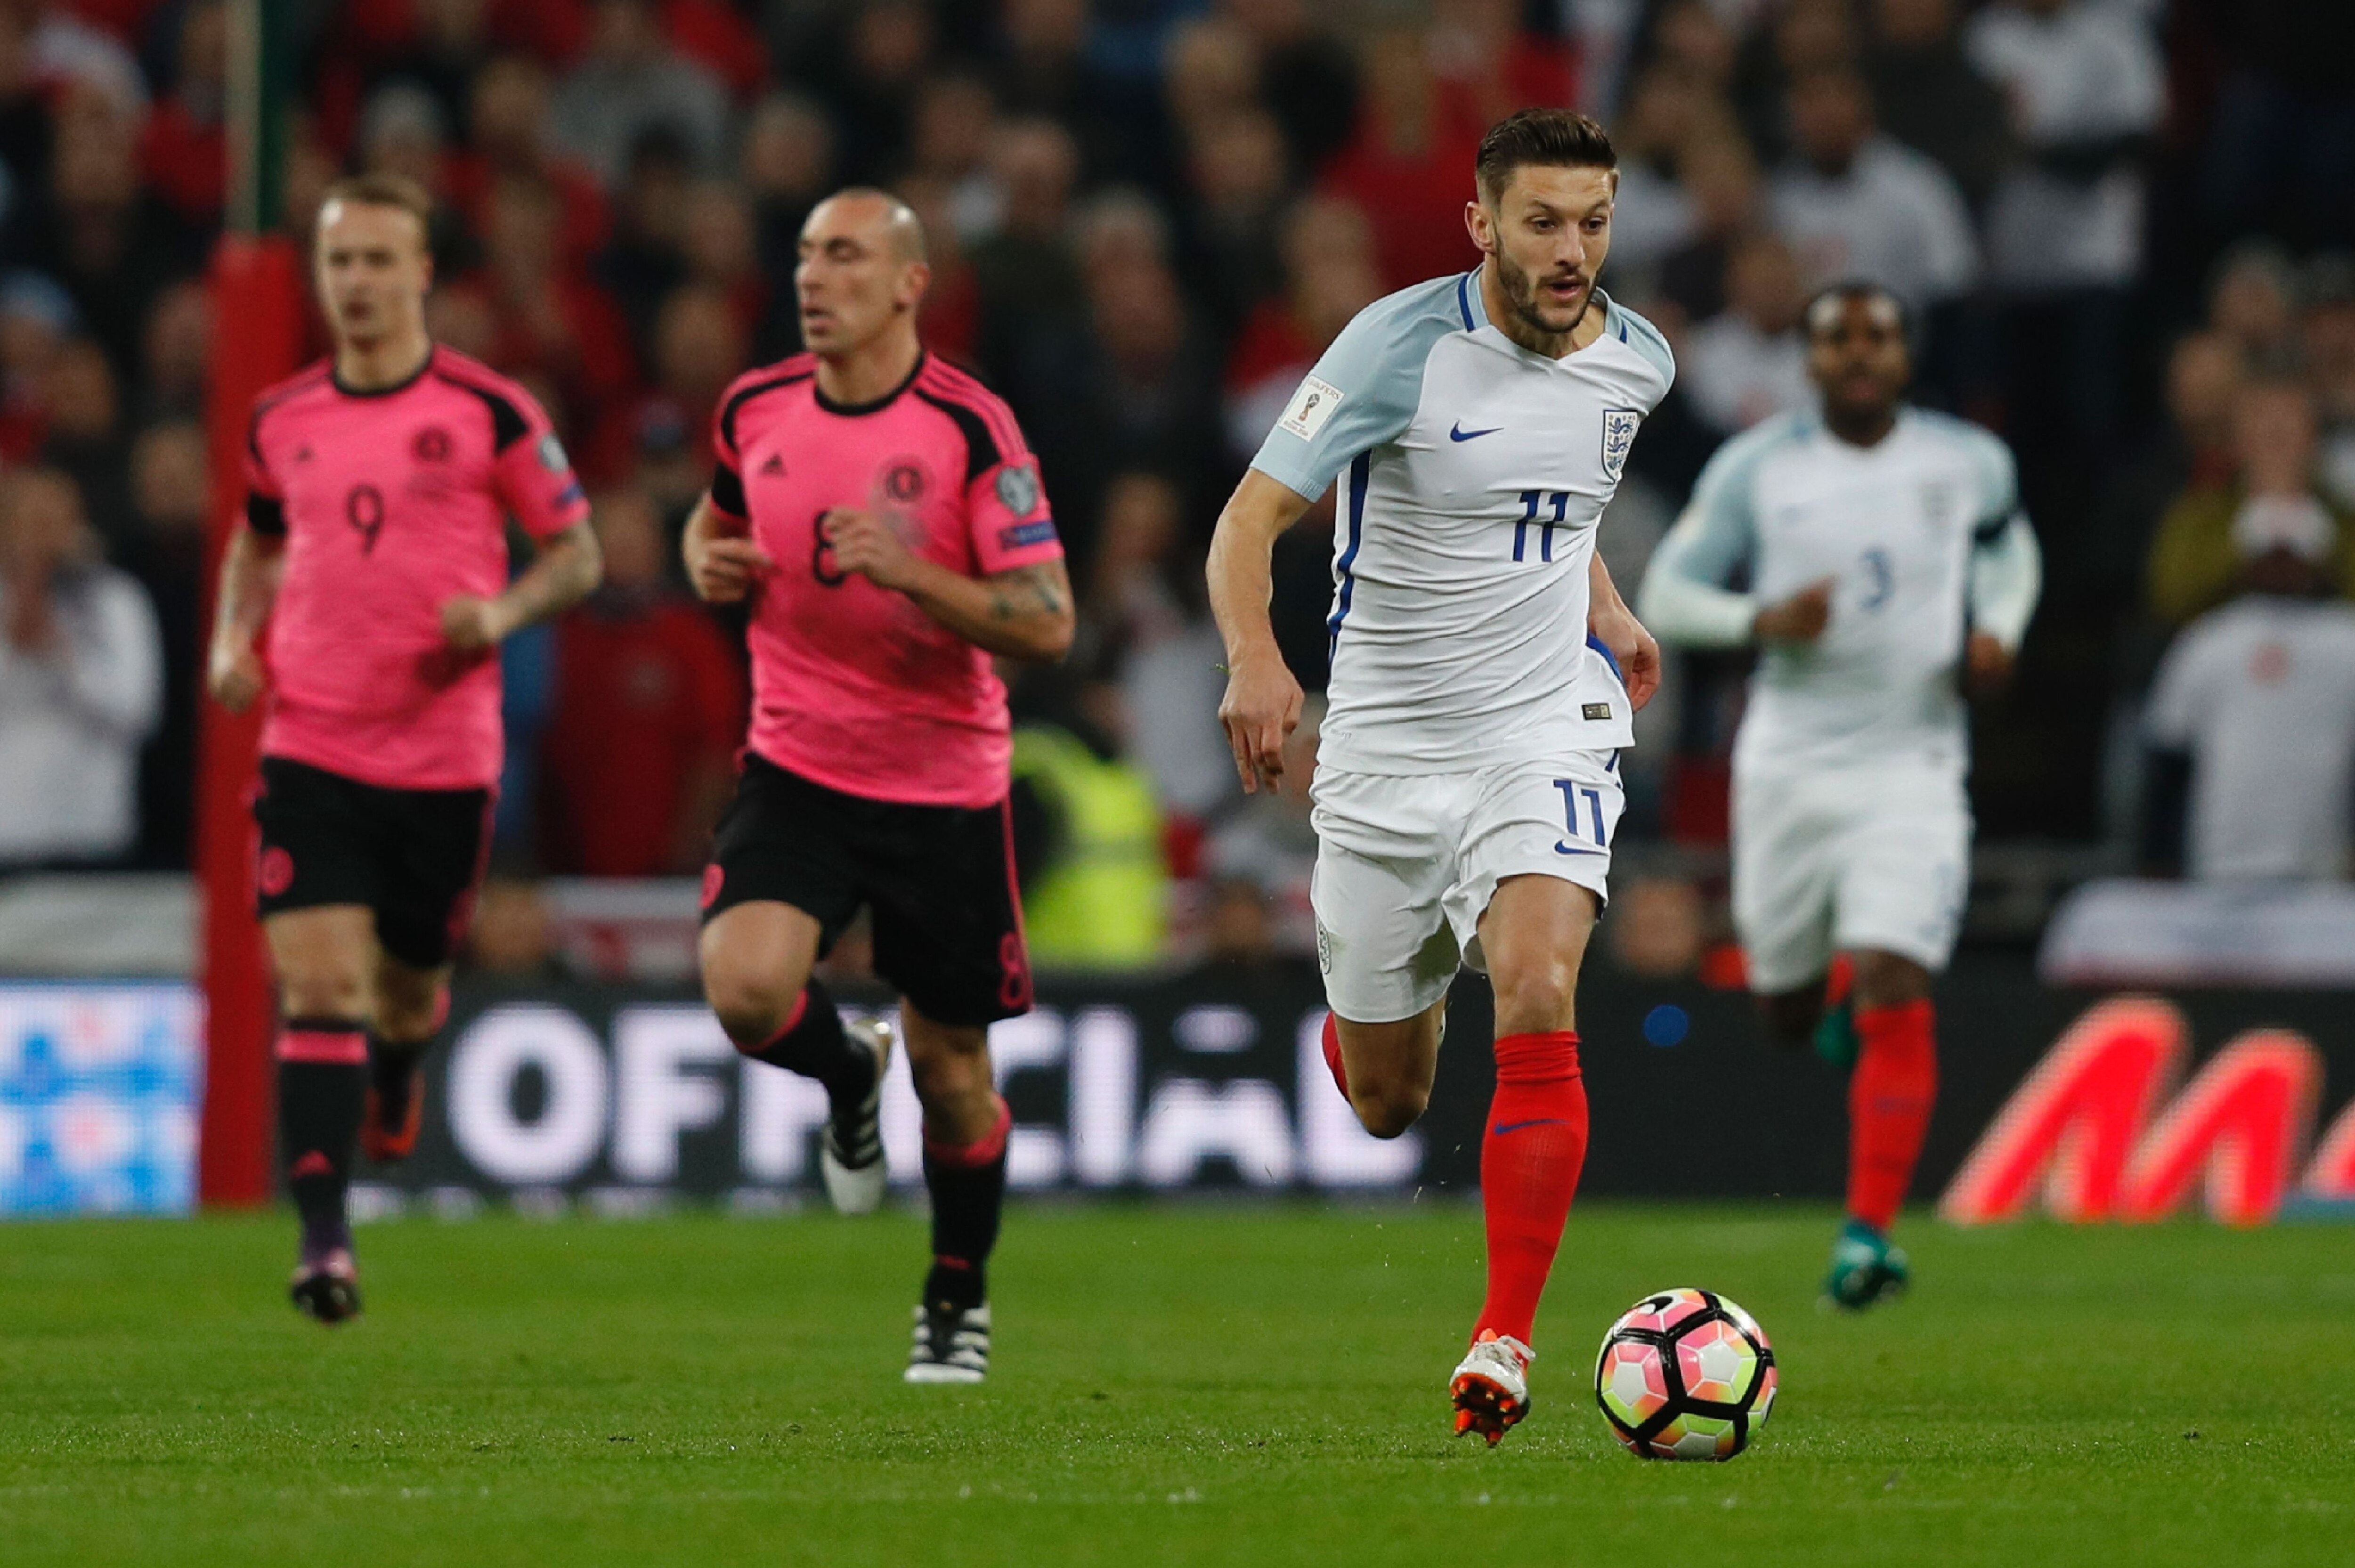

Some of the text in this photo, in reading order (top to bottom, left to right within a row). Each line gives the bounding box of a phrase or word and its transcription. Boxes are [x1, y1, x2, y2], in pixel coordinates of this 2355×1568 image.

[348, 484, 383, 554] 9
[812, 510, 848, 587] 8
[1512, 490, 1569, 562] 11
[1859, 545, 1895, 611] 3
[1553, 779, 1605, 846] 11
[998, 931, 1031, 1007] 8
